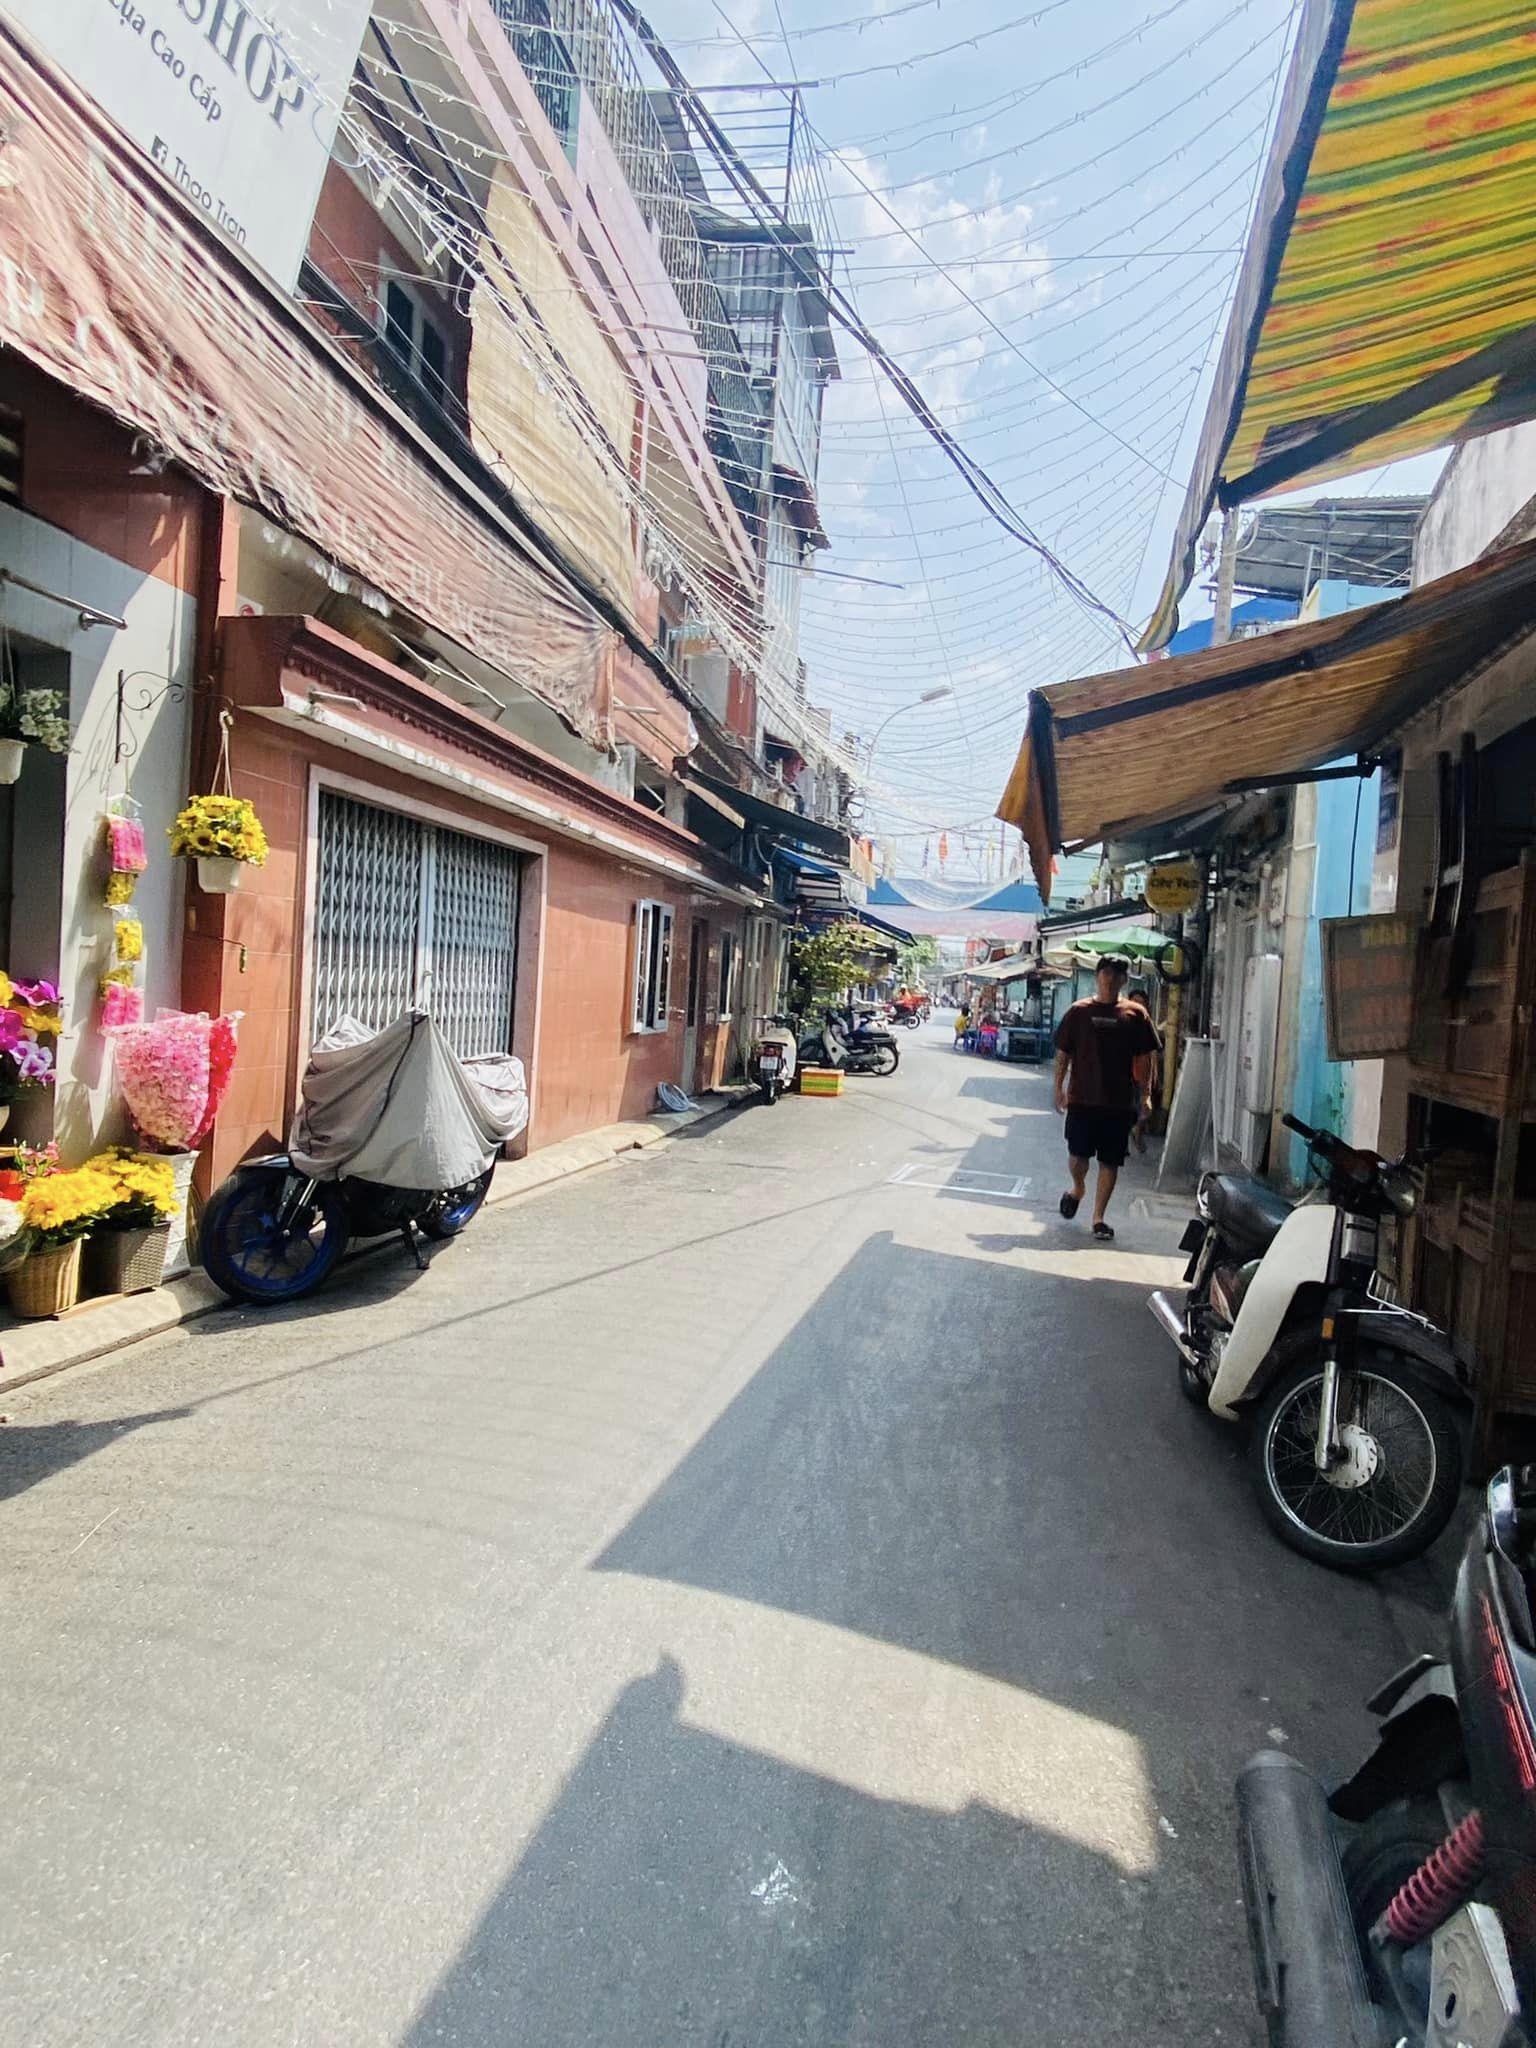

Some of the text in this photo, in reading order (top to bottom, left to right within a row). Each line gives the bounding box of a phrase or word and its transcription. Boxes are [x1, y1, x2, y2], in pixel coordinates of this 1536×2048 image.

[151, 29, 185, 79] Cao
[189, 73, 222, 122] Cấp
[174, 156, 213, 210] Thao
[216, 199, 247, 245] Tran
